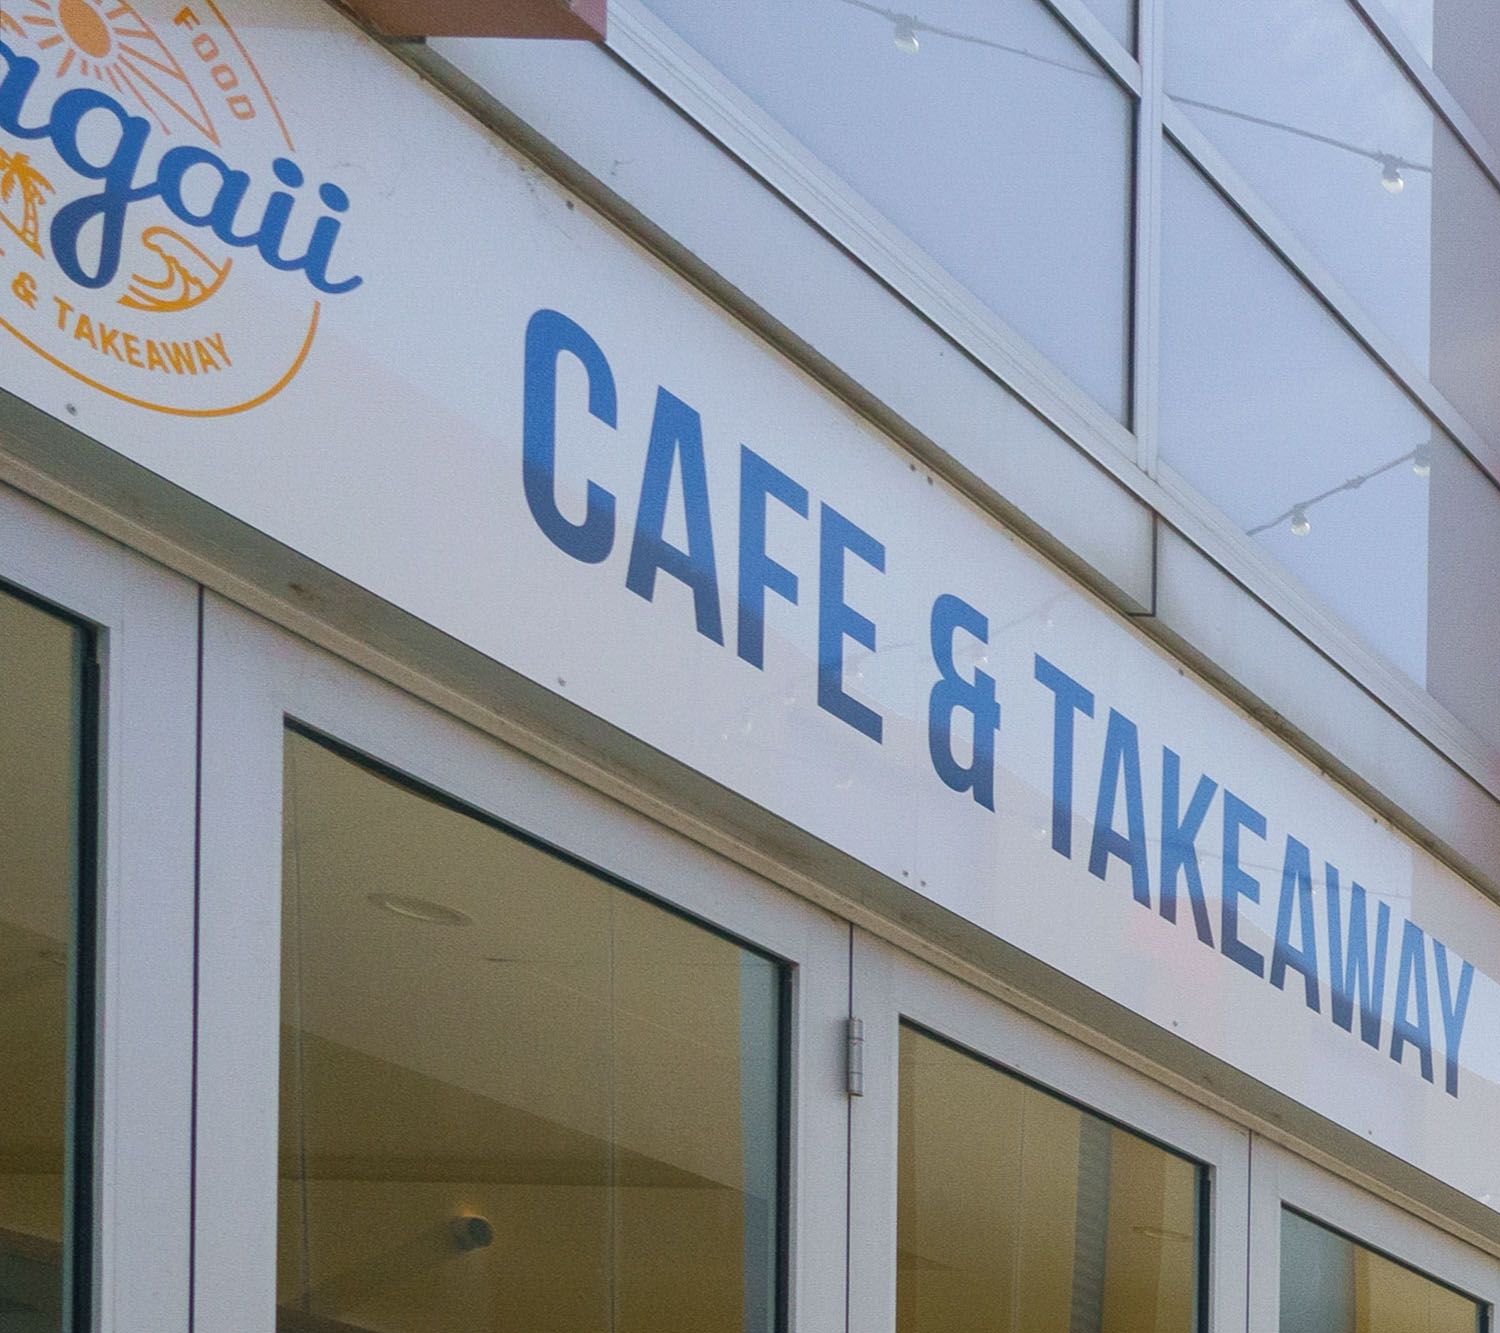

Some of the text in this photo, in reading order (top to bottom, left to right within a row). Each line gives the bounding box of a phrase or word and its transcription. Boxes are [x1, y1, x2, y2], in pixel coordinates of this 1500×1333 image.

[173, 4, 257, 121] FOOD
[53, 295, 233, 376] TAKEAWAY
[522, 307, 1476, 1099] CAFE & TAKEAWAY
